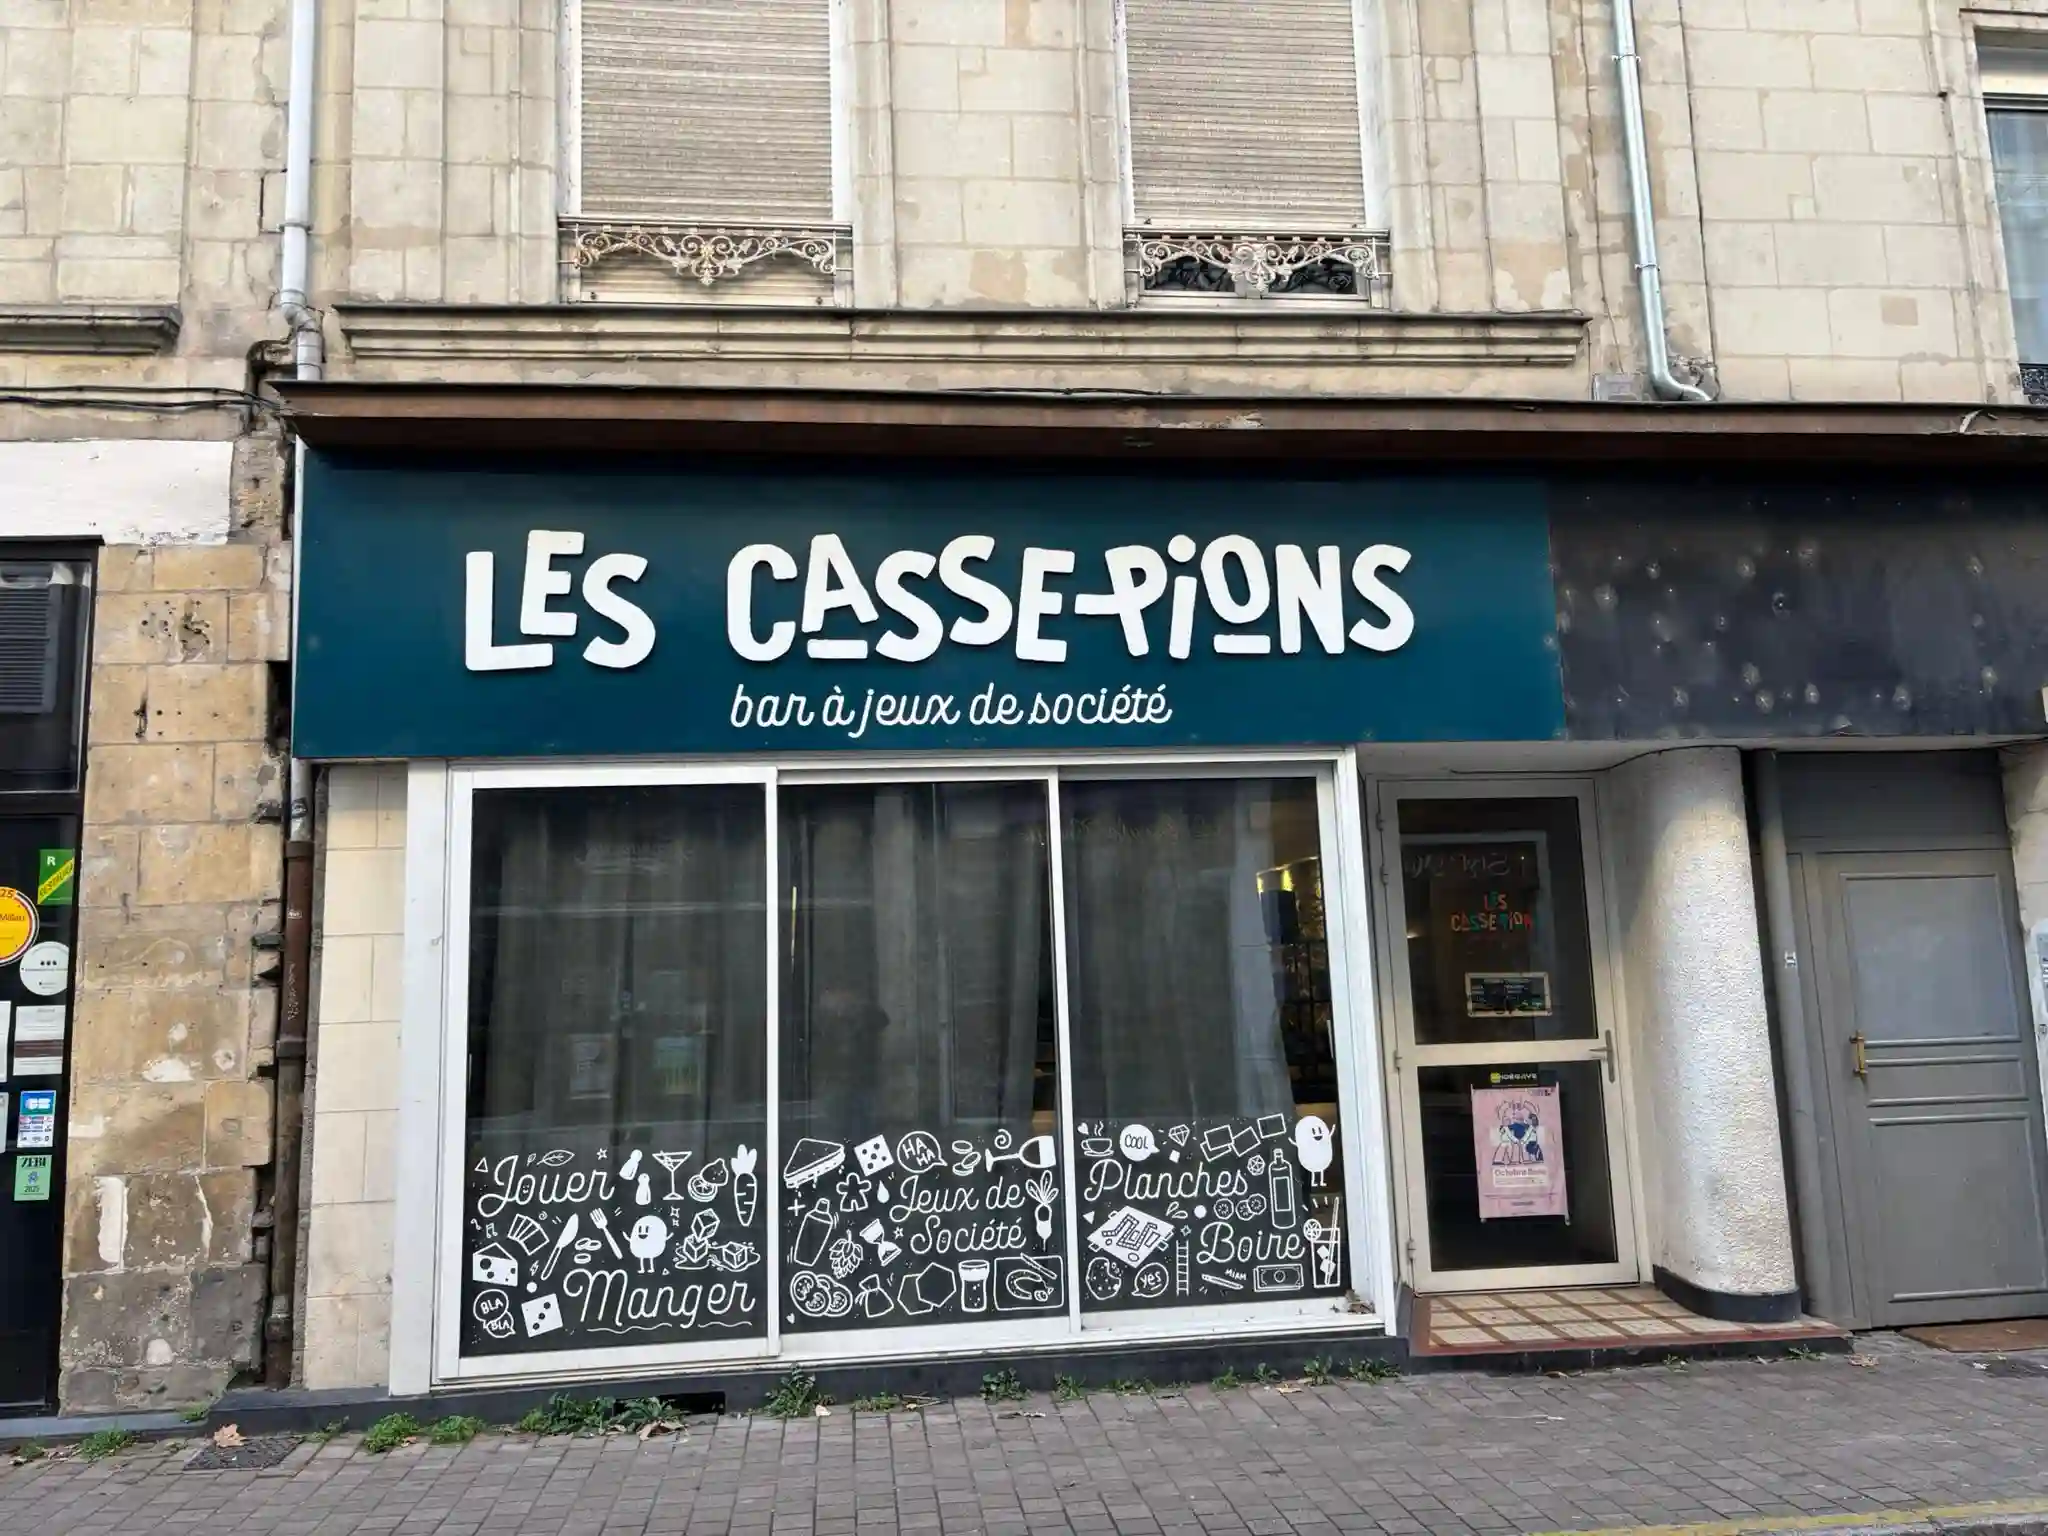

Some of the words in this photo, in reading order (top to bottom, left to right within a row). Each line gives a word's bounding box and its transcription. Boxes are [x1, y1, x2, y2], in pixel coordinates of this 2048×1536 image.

[466, 530, 656, 671] LES
[730, 683, 815, 728] bar
[822, 685, 856, 726] à
[848, 688, 961, 738] jeux
[969, 682, 1023, 725] de
[1027, 683, 1173, 725] société
[902, 1137, 927, 1160] HA
[916, 1148, 936, 1166] HA
[1125, 1134, 1149, 1150] COOL
[478, 1155, 615, 1218] Jouer
[889, 1175, 979, 1222] Jeux
[985, 1176, 1026, 1210] de
[1084, 1158, 1249, 1200] Planches
[910, 1215, 1026, 1255] Société
[1196, 1221, 1306, 1264] Boire
[480, 1298, 504, 1315] BLA
[563, 1268, 756, 1328] Manger
